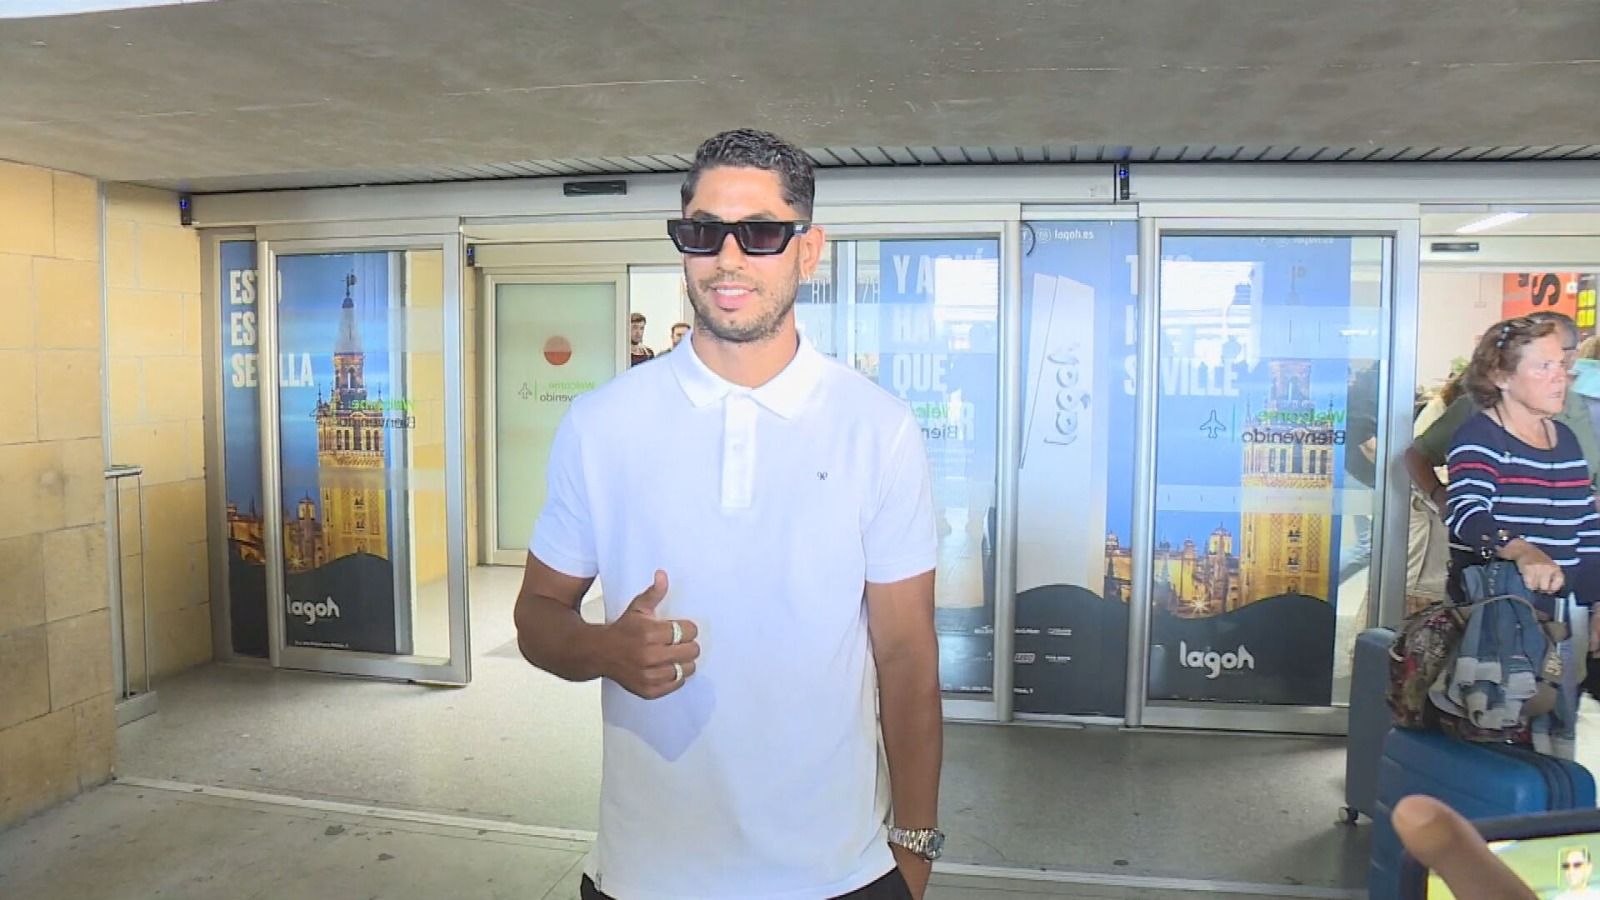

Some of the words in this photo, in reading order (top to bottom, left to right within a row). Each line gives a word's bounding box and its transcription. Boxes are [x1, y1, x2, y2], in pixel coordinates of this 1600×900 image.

[231, 352, 315, 388] SELLA
[1123, 354, 1240, 396] SVILLE
[286, 593, 341, 626] lagoh
[1179, 640, 1255, 680] lagoh
